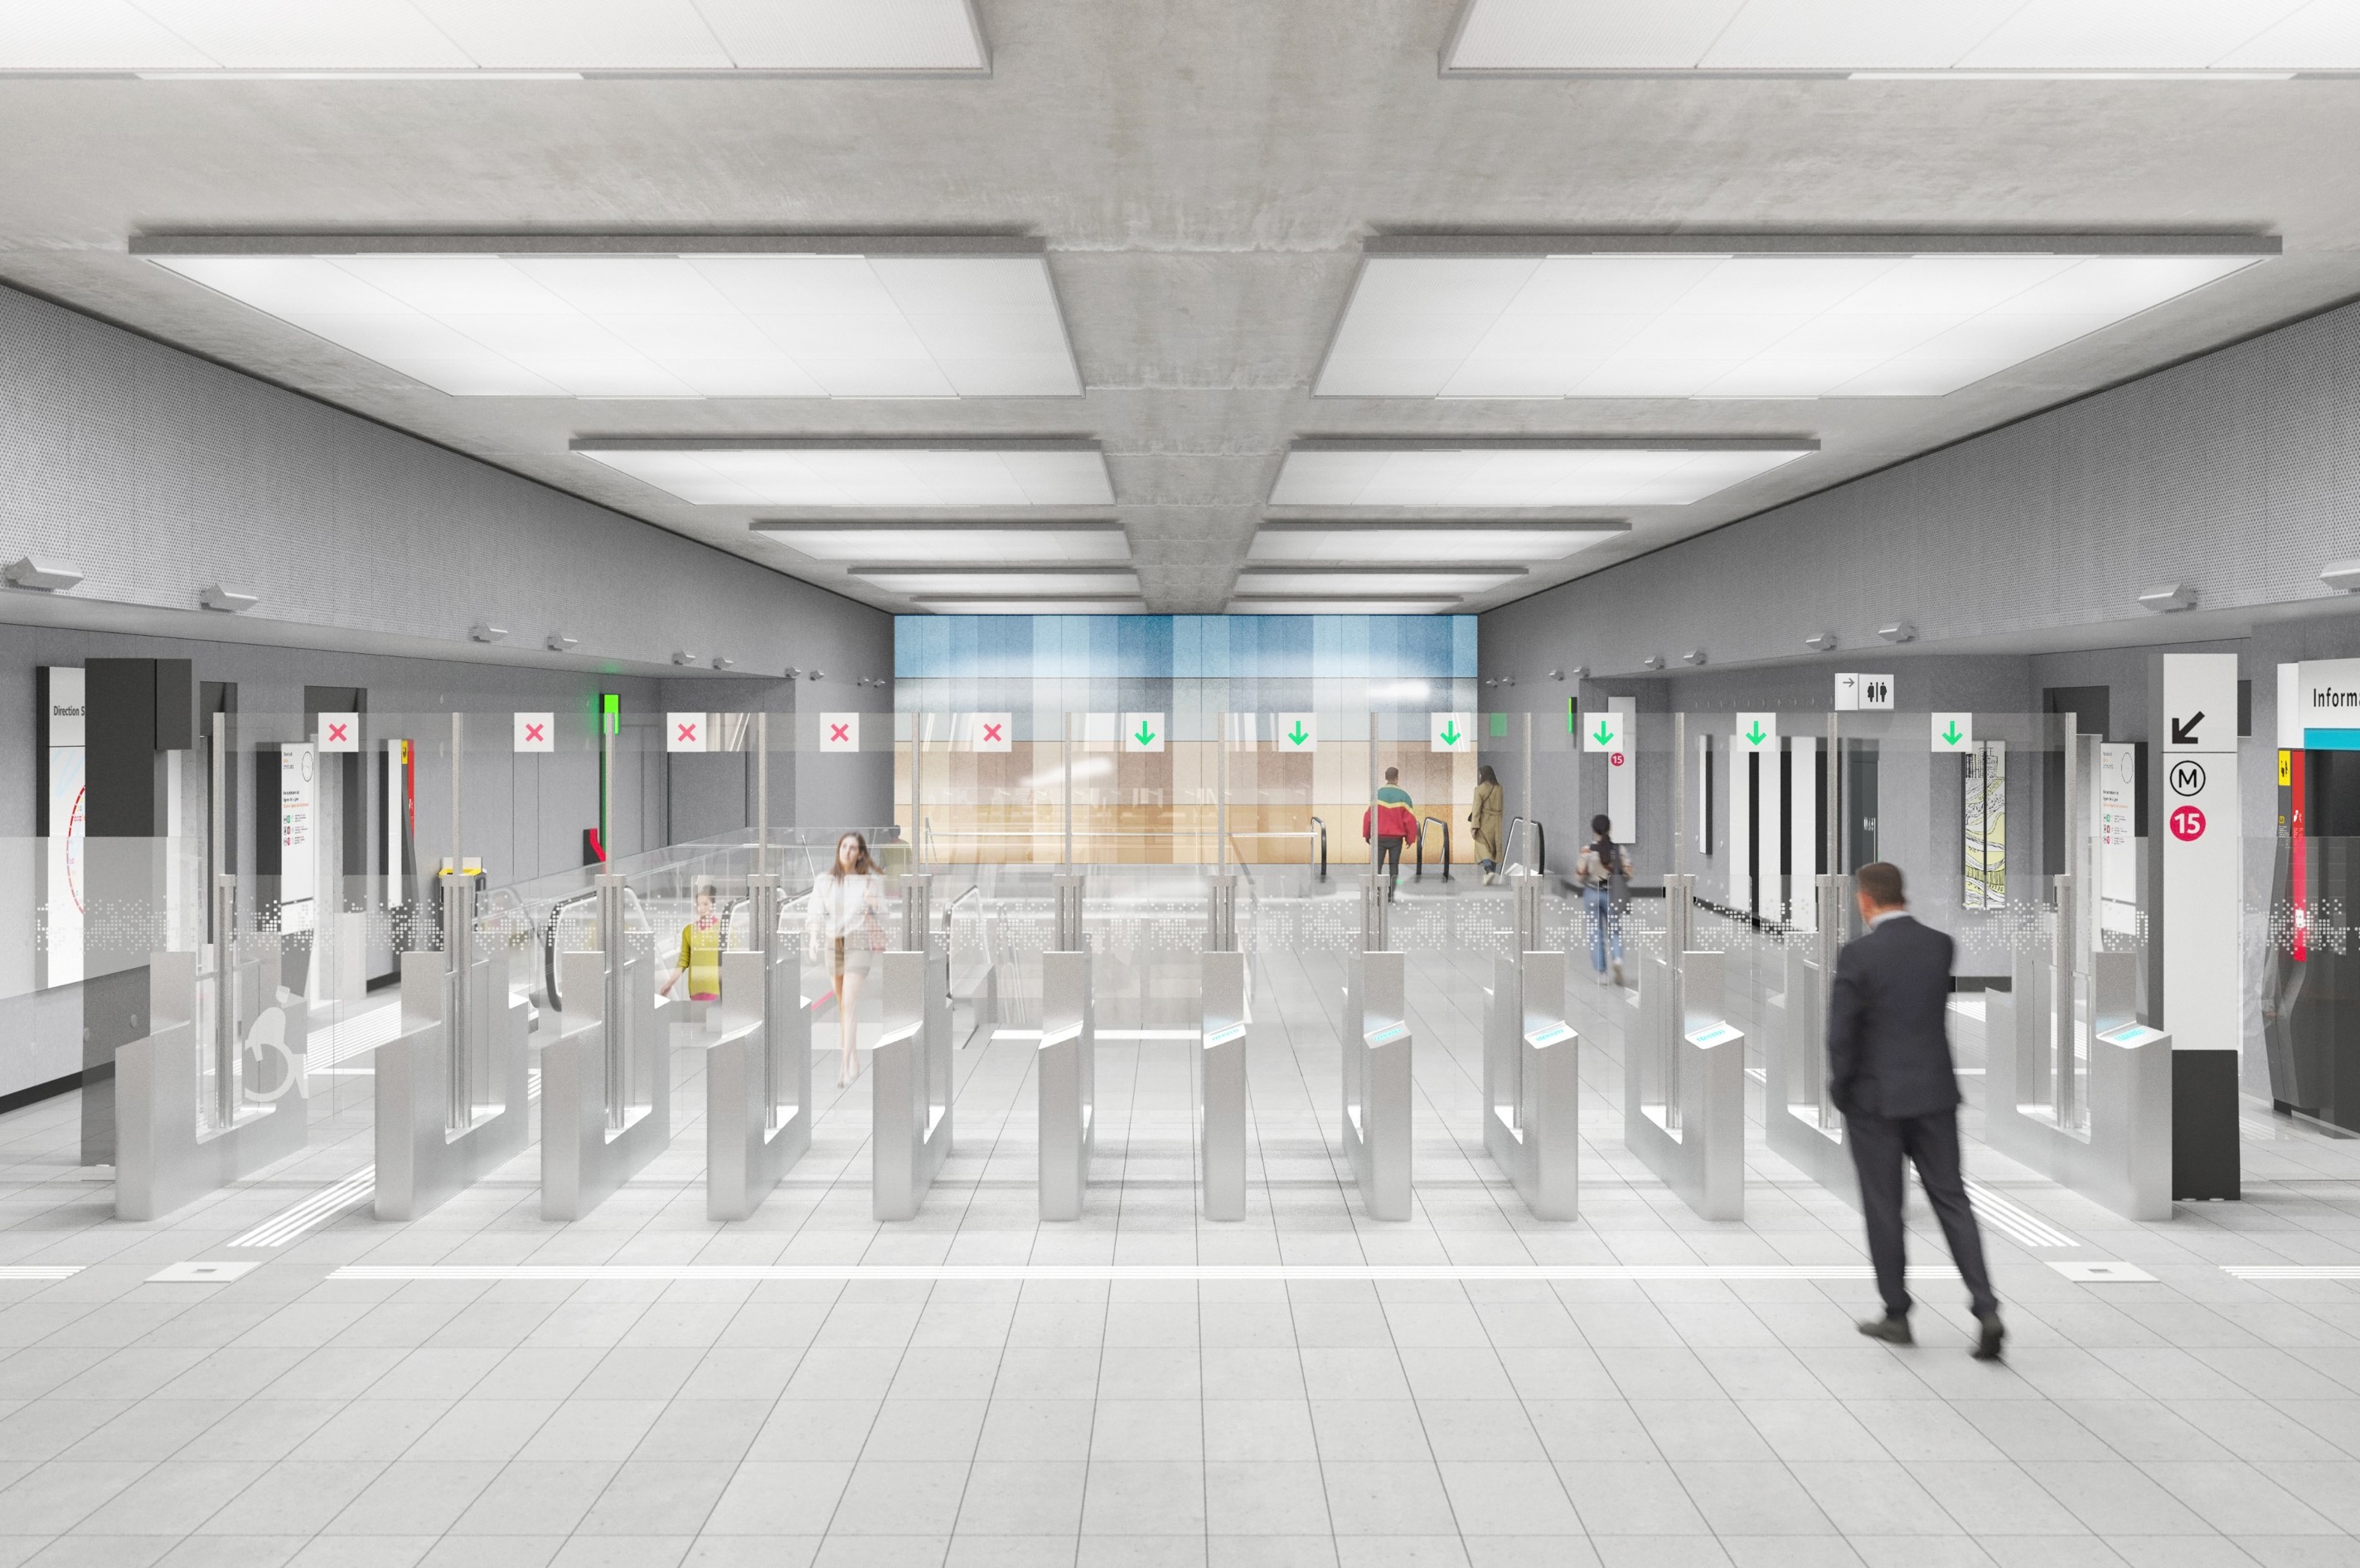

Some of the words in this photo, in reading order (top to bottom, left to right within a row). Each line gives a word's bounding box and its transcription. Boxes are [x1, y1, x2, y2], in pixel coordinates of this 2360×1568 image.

[2314, 687, 2360, 707] Inform
[53, 705, 80, 716] Direction
[1612, 755, 1623, 764] 15
[2178, 768, 2198, 788] M
[2173, 813, 2201, 835] 15
